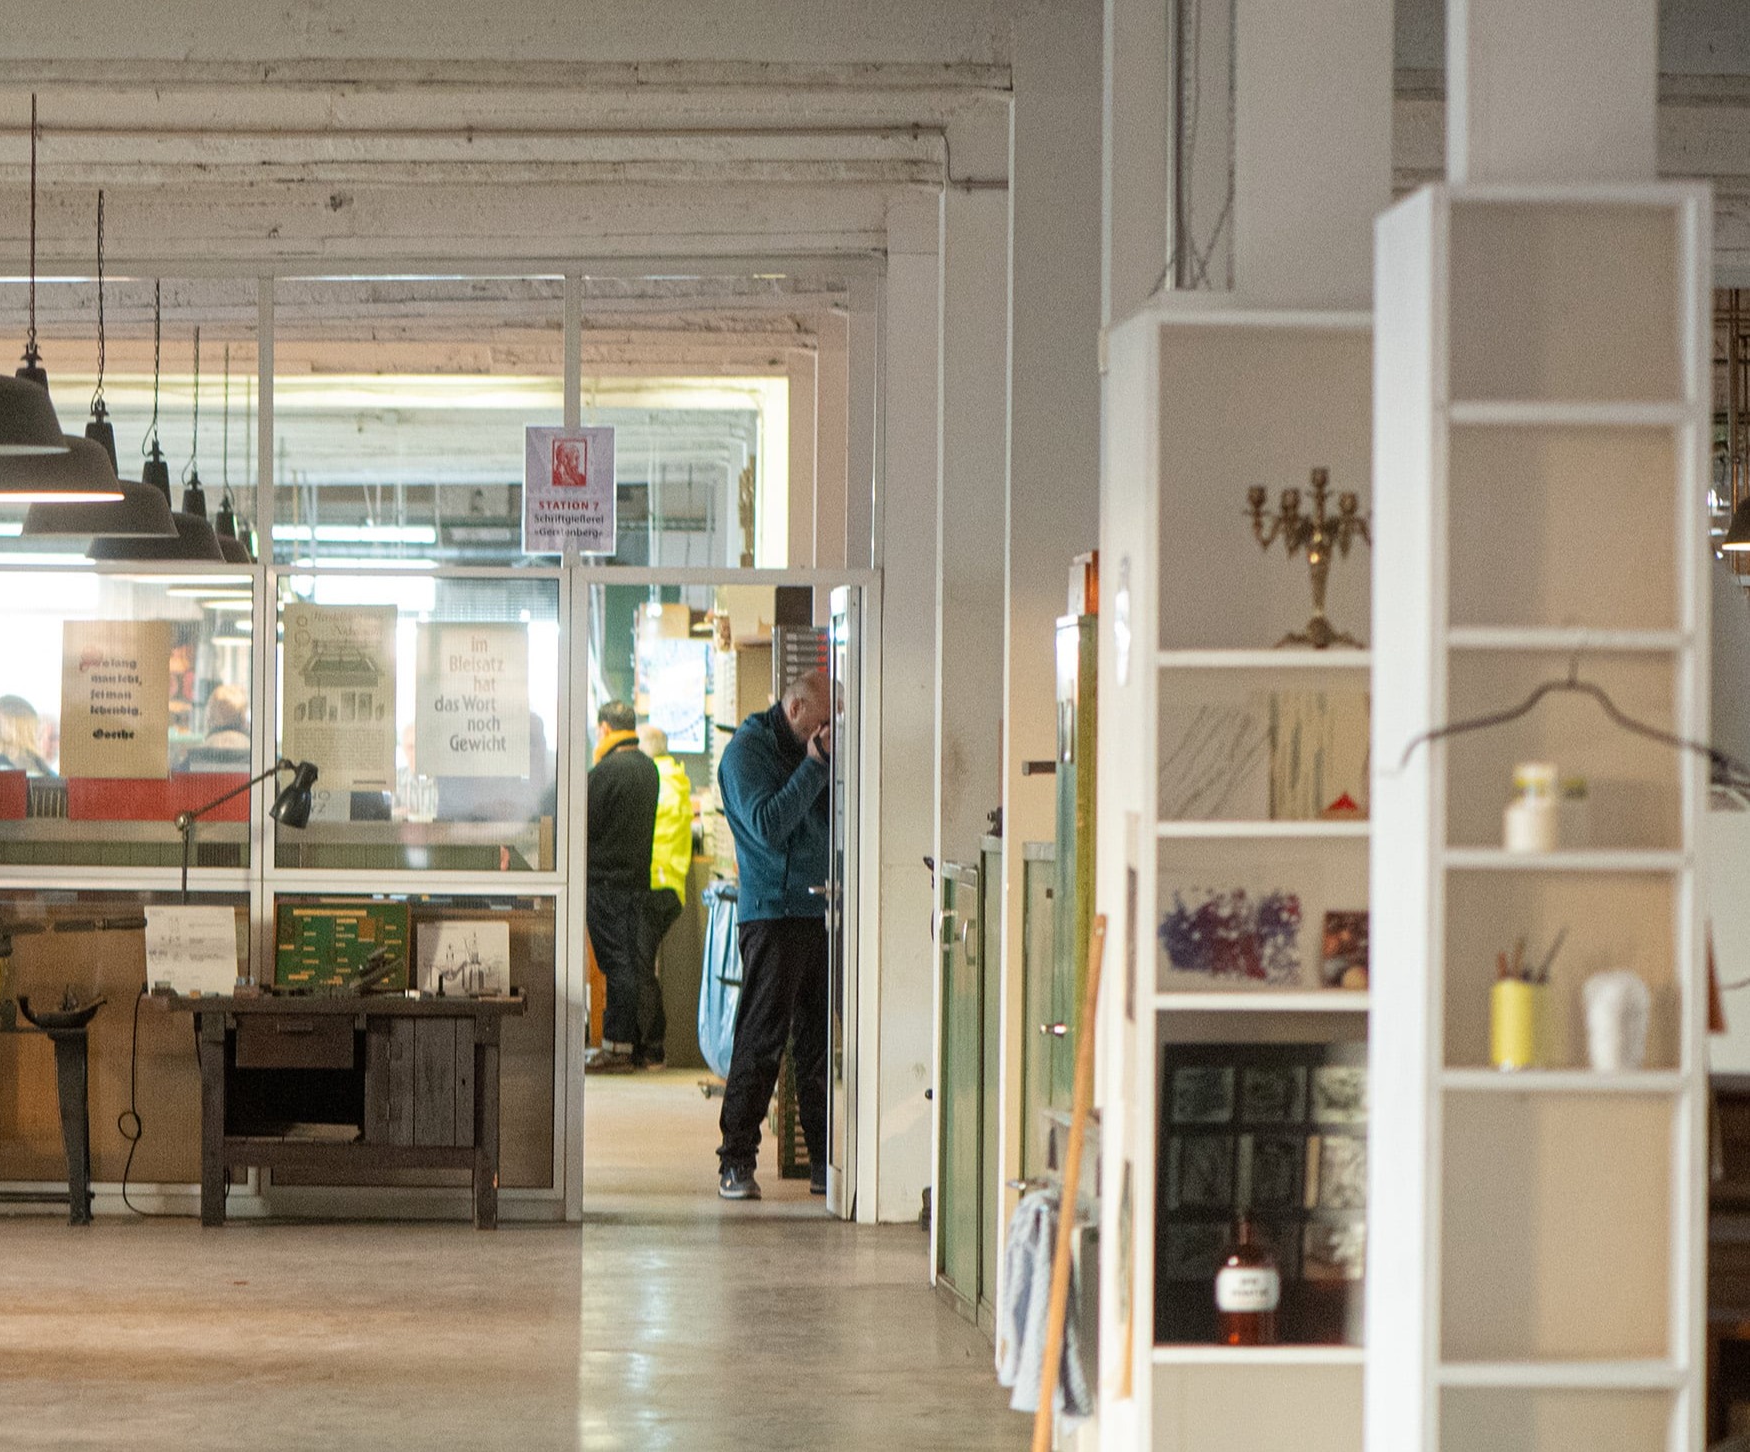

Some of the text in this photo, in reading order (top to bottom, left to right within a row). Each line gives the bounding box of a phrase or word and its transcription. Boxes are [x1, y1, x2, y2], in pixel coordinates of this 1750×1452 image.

[539, 501, 599, 511] STATION 7
[471, 636, 488, 653] im
[449, 656, 505, 672] Bleisatz
[473, 676, 496, 692] hat
[434, 695, 497, 712] das Wort
[467, 715, 501, 732] noch
[449, 735, 507, 753] Gewicht
